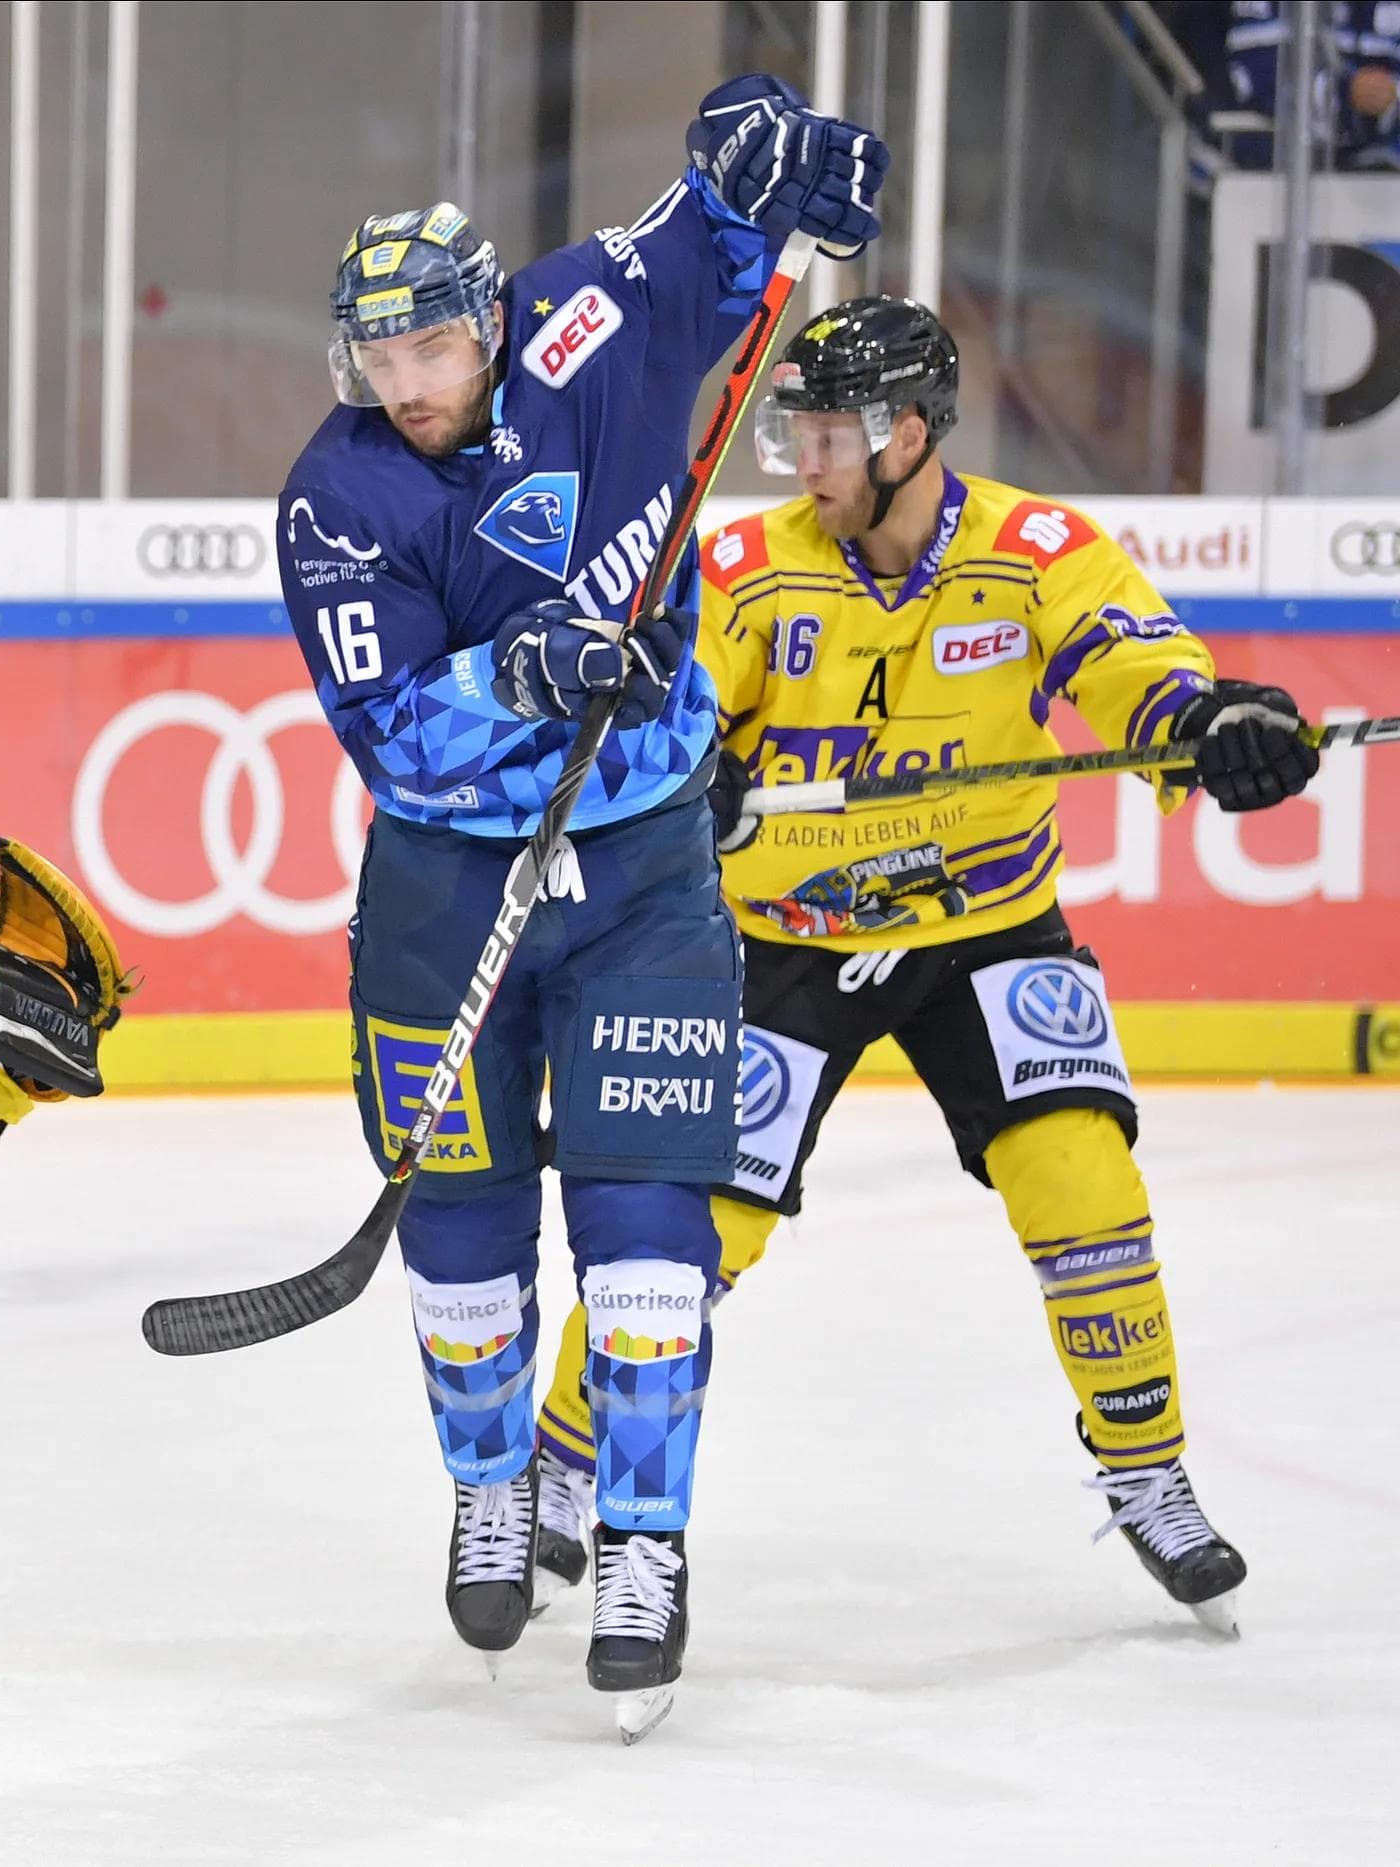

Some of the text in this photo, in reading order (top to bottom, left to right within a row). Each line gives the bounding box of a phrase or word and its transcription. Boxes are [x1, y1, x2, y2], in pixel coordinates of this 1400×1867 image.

[357, 295, 411, 317] EDEKA
[540, 295, 605, 377] DEL
[1117, 525, 1249, 570] Audi
[317, 601, 383, 685] 16
[942, 628, 1020, 663] DEL
[855, 656, 890, 719] A
[774, 825, 845, 849] LADEN
[854, 815, 921, 848] LEBEN
[930, 805, 969, 833] AUF
[424, 894, 526, 1113] BAUER
[592, 1015, 727, 1058] HERRN
[598, 1075, 715, 1116] BRÄU
[388, 1131, 477, 1160] EEKA
[1055, 1244, 1141, 1273] BAUER
[1060, 1309, 1165, 1355] lekker
[1093, 1383, 1171, 1412] CURANTO
